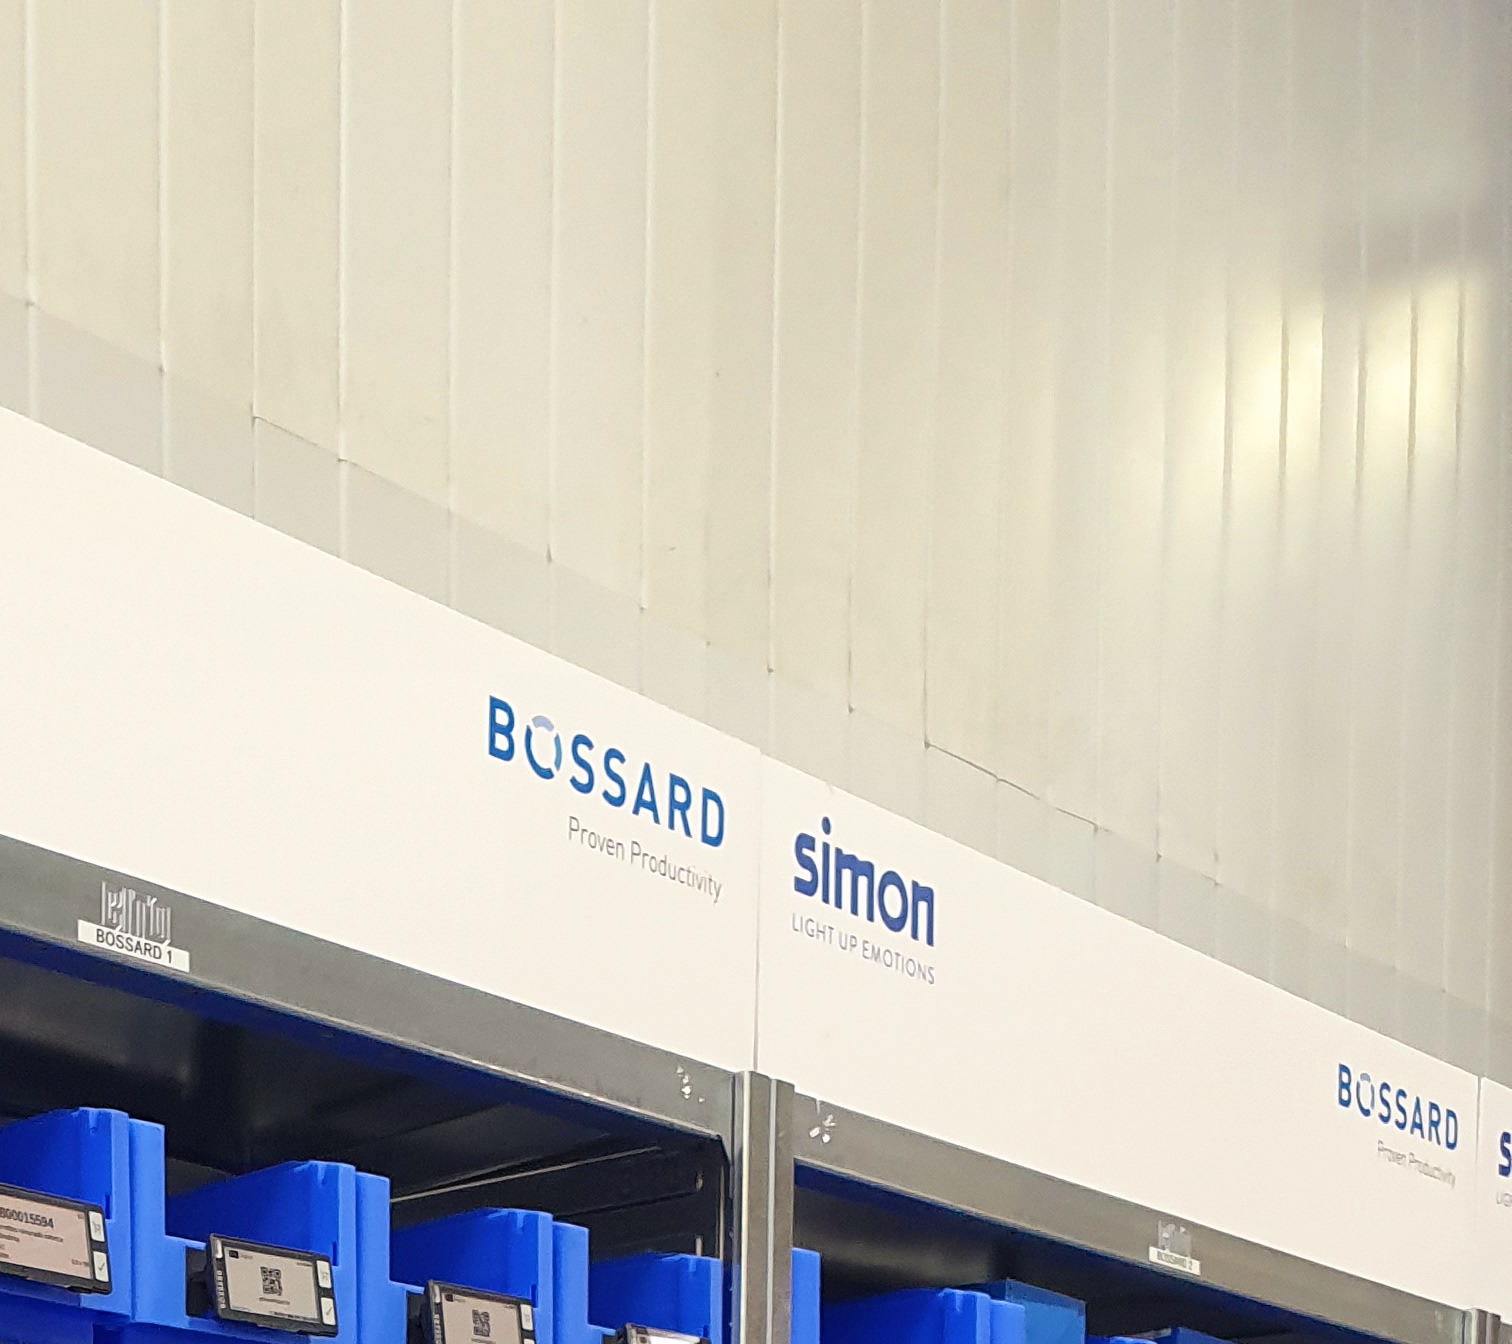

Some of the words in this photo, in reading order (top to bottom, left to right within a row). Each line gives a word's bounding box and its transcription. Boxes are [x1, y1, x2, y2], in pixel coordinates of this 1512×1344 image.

[488, 695, 725, 847] BOSSARD
[569, 816, 624, 861] Proven
[630, 841, 722, 904] Productivity
[794, 817, 935, 947] simon
[96, 929, 162, 959] BOSSARD
[167, 951, 171, 963] 1
[792, 913, 834, 945] LIGHT
[839, 930, 858, 955] UP
[862, 941, 935, 985] EMOTIONS
[1338, 1063, 1458, 1151] BOSSARD
